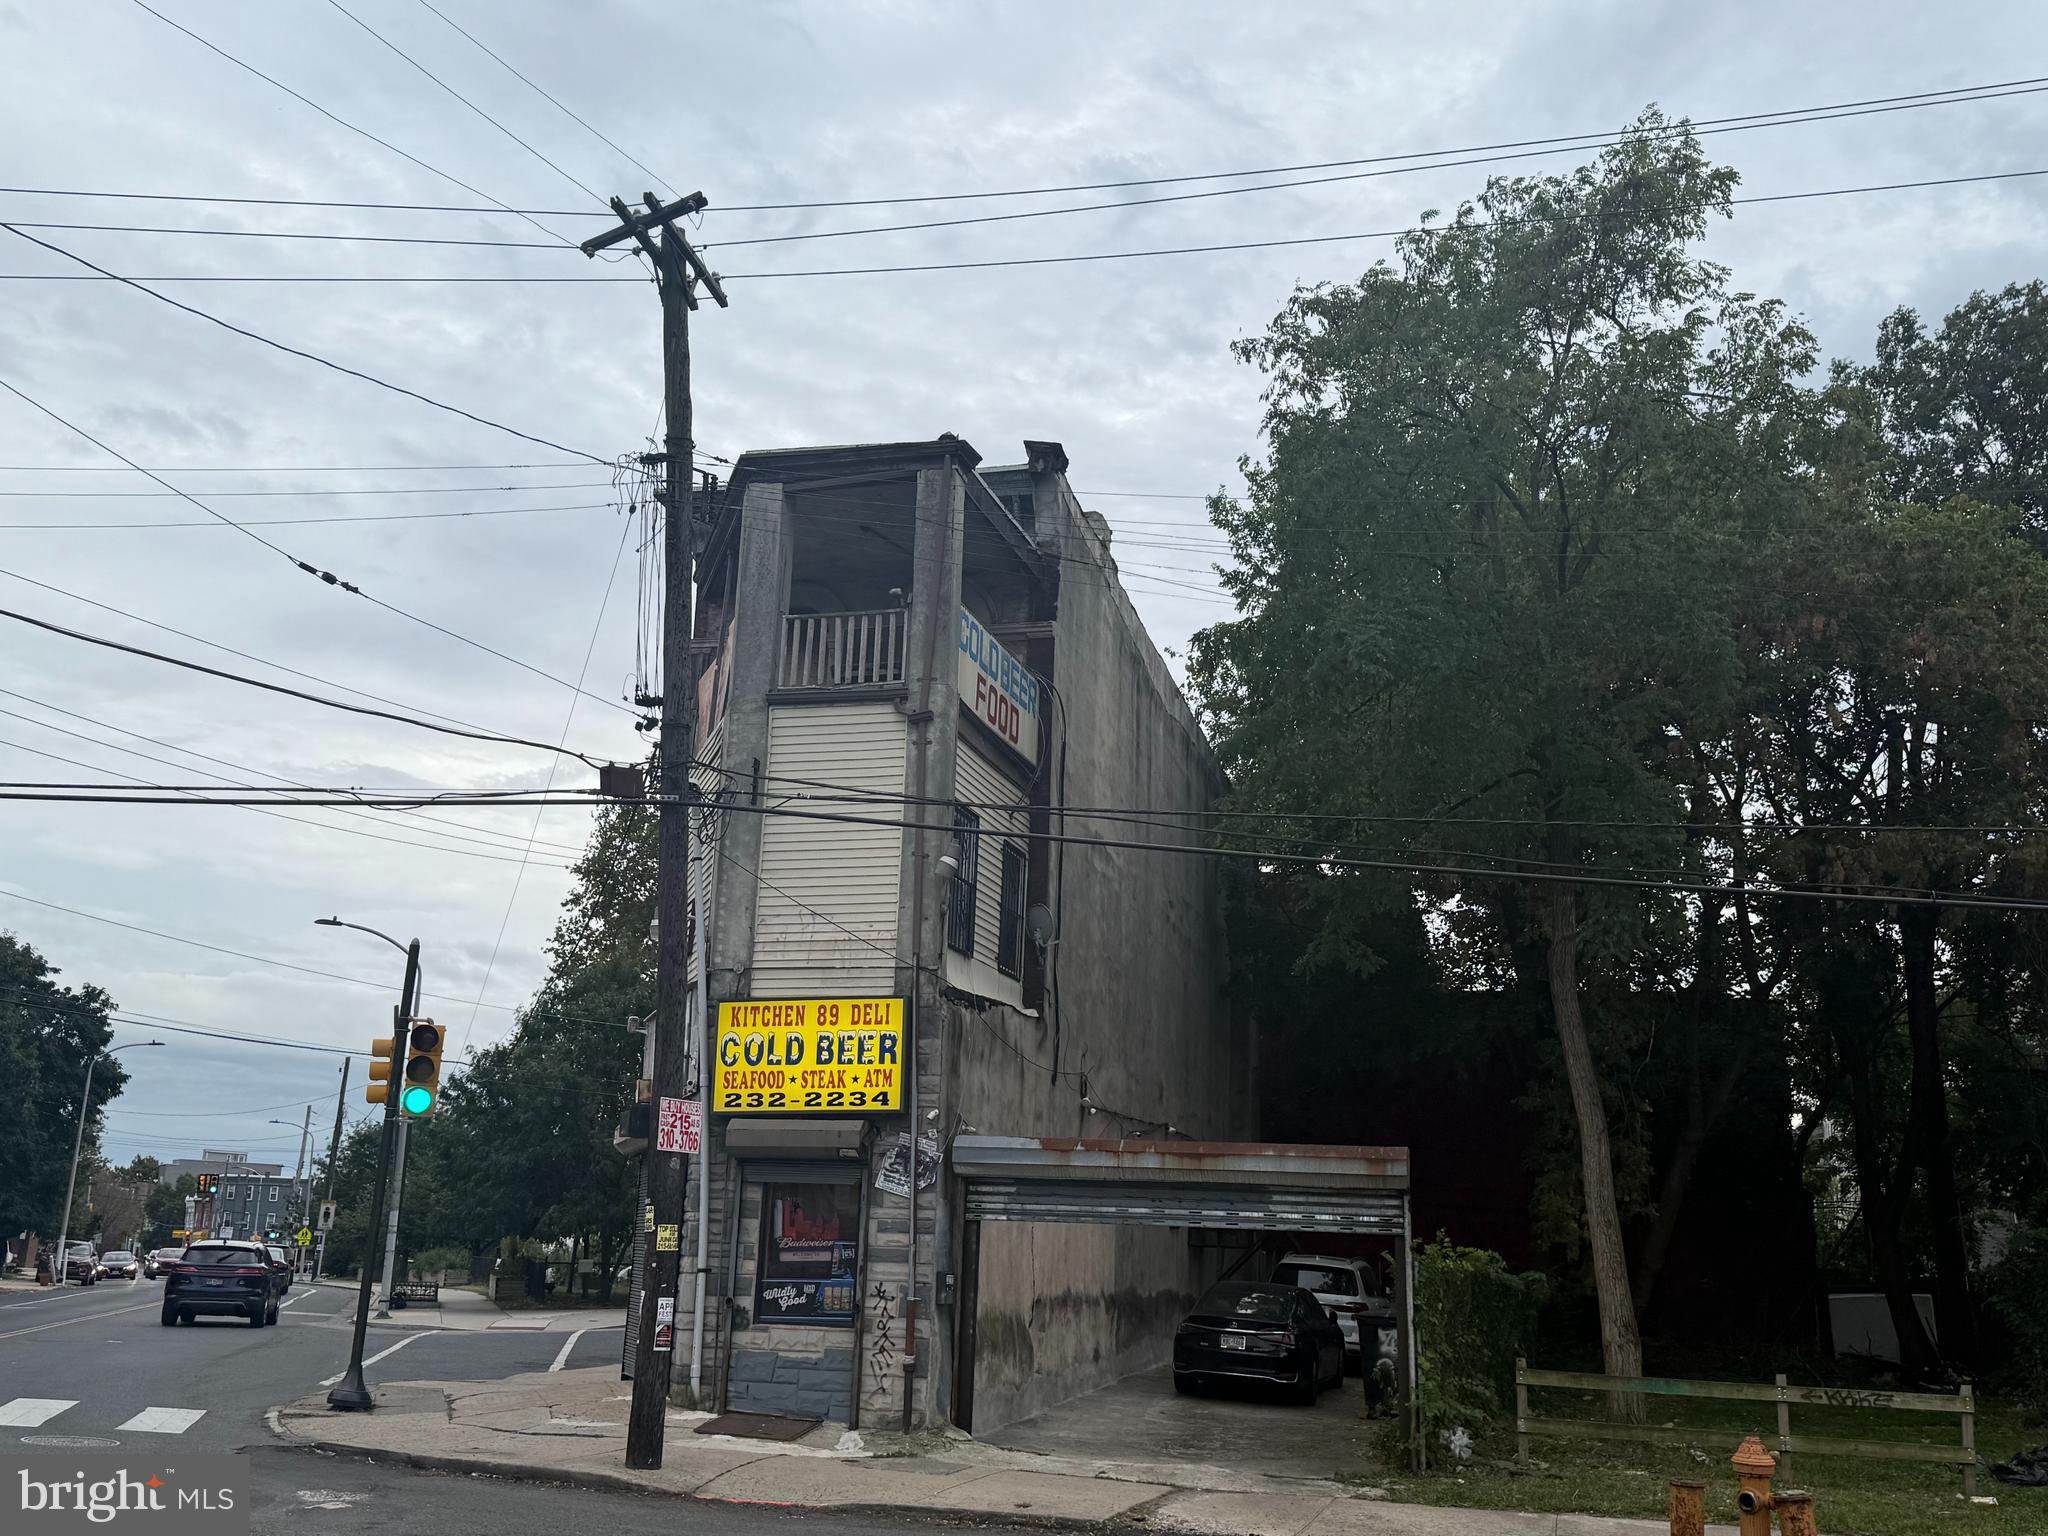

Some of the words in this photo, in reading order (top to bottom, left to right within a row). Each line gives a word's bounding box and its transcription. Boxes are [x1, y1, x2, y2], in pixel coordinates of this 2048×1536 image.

[960, 610, 999, 682] COLD
[1000, 655, 1037, 719] BEER
[976, 672, 1019, 745] FOOD
[731, 1005, 805, 1027] KITCHEN
[817, 1004, 839, 1026] 89
[851, 1003, 890, 1025] DELI
[721, 1030, 805, 1067] COLD
[816, 1029, 899, 1065] BEER
[723, 1070, 785, 1090] SEAFOOD
[800, 1070, 847, 1089] STEAK
[863, 1069, 893, 1088] ATM
[661, 1099, 670, 1112] WE
[670, 1100, 681, 1113] BUY
[681, 1102, 701, 1116] HOUSES
[724, 1091, 890, 1108] 232-2234
[671, 1114, 691, 1130] 215
[659, 1128, 699, 1151] 310-3766
[777, 1237, 834, 1248] Budweiser
[763, 1285, 797, 1300] Wildly
[779, 1294, 807, 1312] Good
